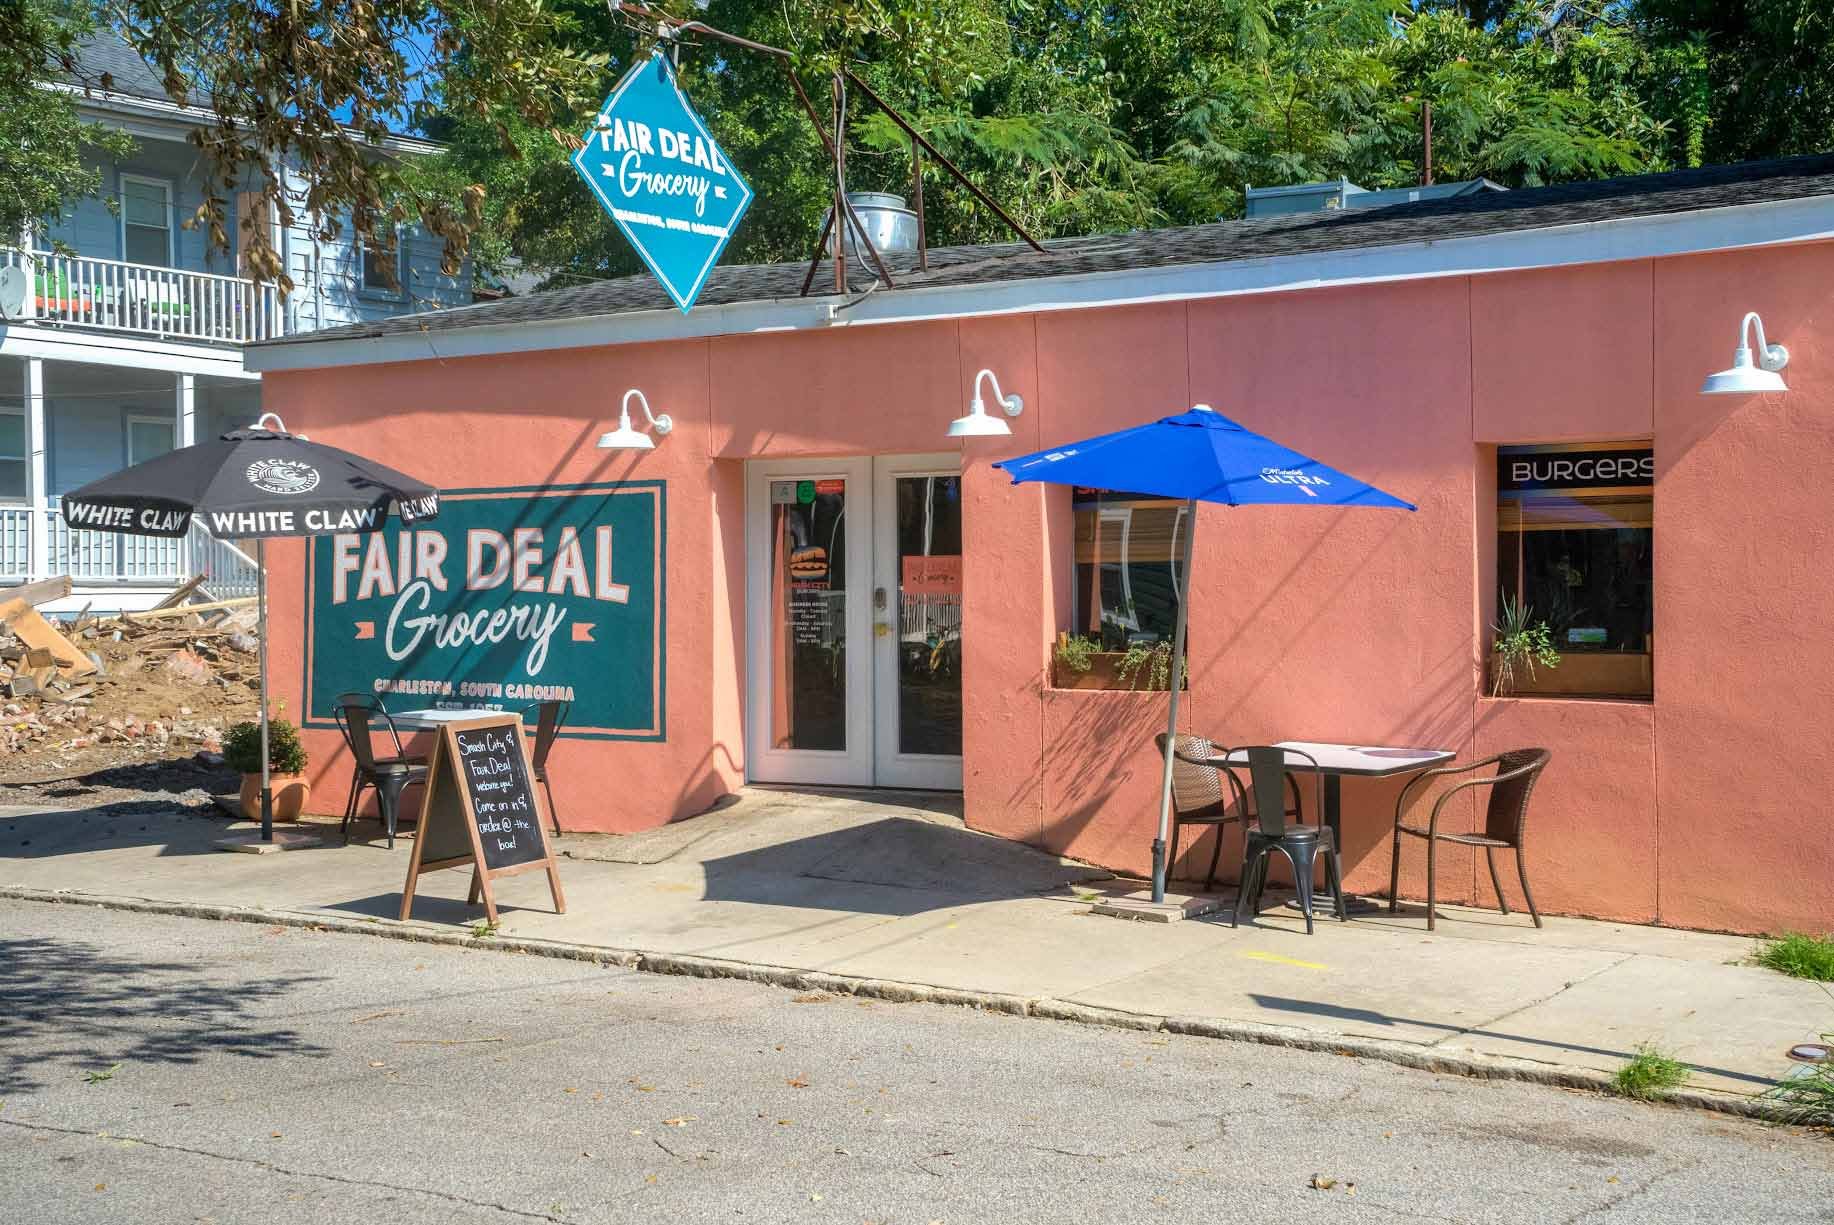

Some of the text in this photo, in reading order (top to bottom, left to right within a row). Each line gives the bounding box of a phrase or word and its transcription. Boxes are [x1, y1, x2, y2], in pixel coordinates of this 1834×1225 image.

[598, 114, 726, 176] FAIR DEAL
[619, 149, 710, 217] Grocery
[1259, 474, 1331, 486] ULTRA
[68, 501, 187, 531] WHITE CLAW
[211, 511, 296, 533] WHITE
[304, 508, 377, 530] CLAW
[332, 526, 631, 605] FAIR DEAL
[385, 576, 568, 677] Grocery
[374, 677, 576, 702] CHARLESTON, SOUTH CAROLINA
[458, 735, 486, 756] Smash
[486, 733, 507, 755] City
[488, 756, 512, 775] Deal
[475, 797, 497, 814] Come
[498, 802, 509, 811] on
[510, 801, 520, 811] in
[478, 815, 529, 834] order @ the
